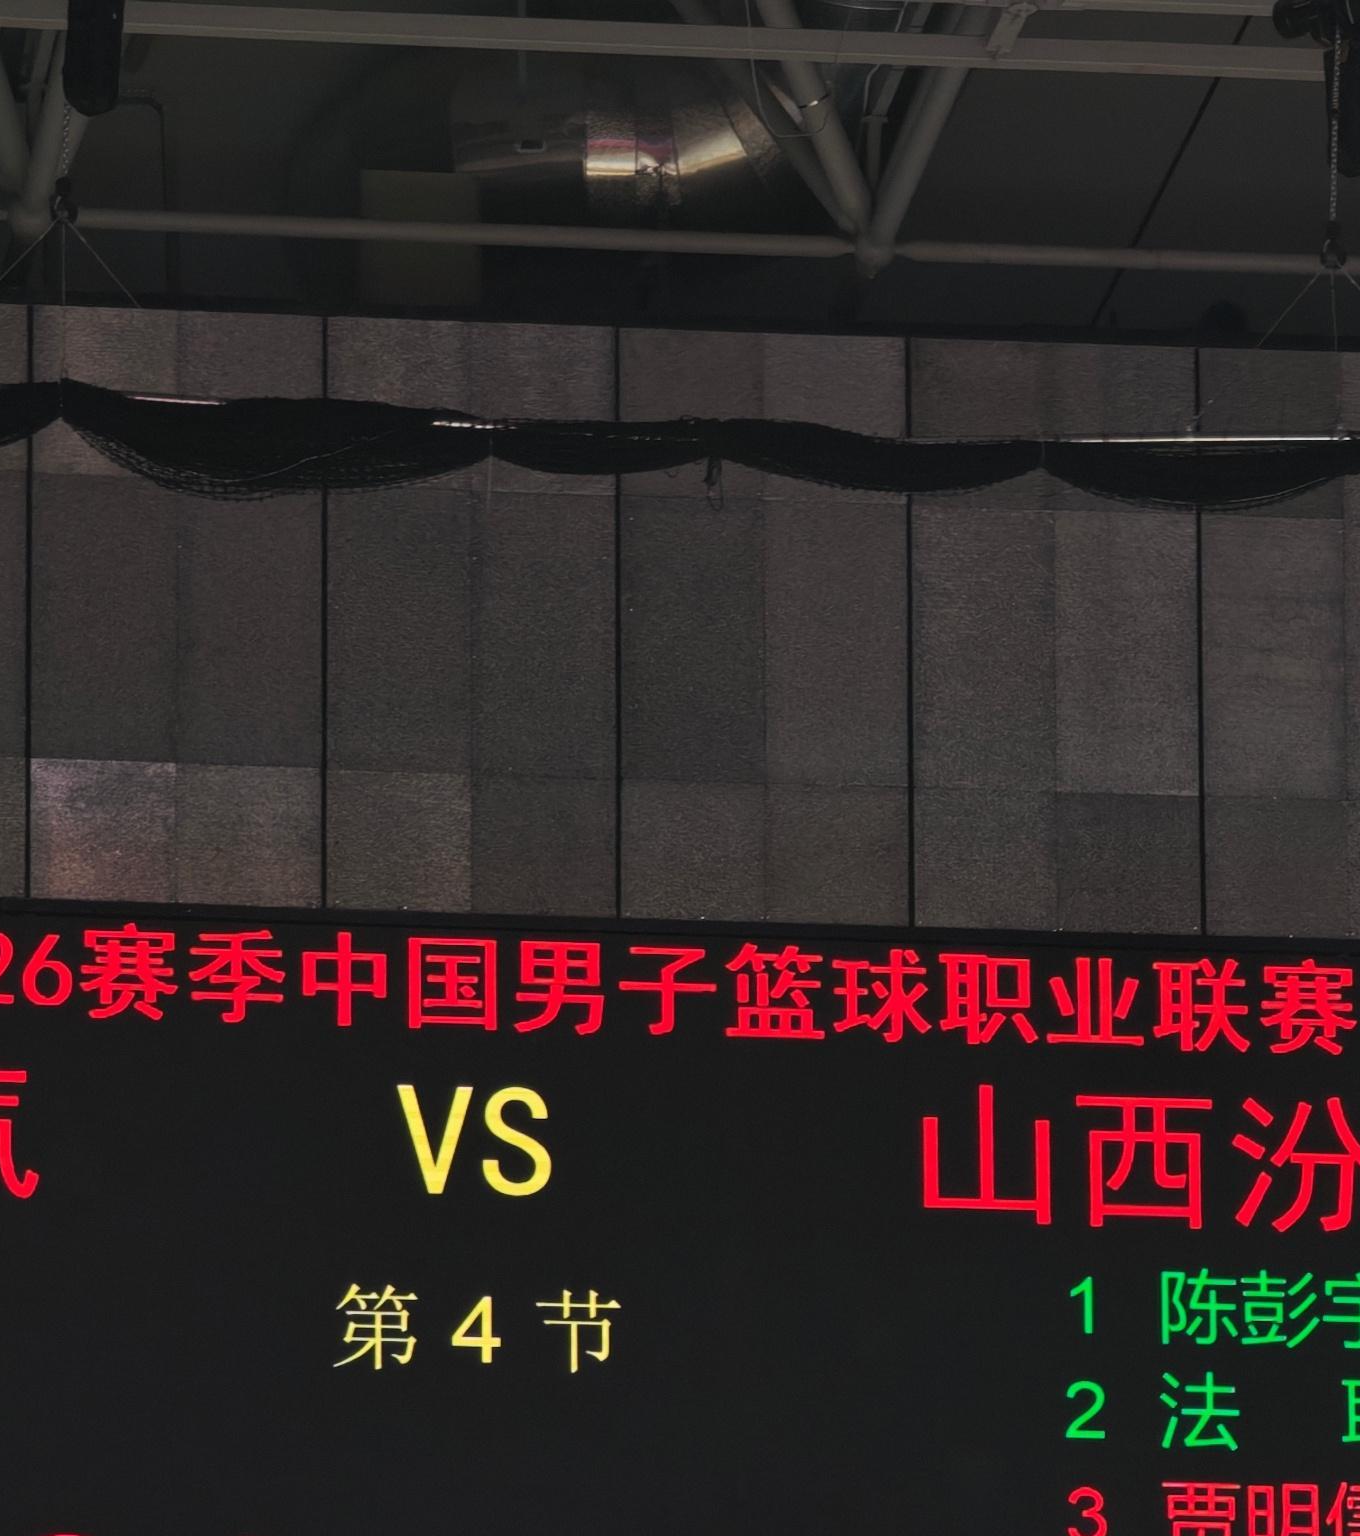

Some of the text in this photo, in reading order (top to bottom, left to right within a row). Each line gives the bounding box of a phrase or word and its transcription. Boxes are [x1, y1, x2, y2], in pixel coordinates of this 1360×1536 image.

[395, 1082, 554, 1198] VS
[332, 1282, 623, 1375] 第 4 节
[1069, 1275, 1094, 1335] 1
[1064, 1379, 1107, 1440] 2
